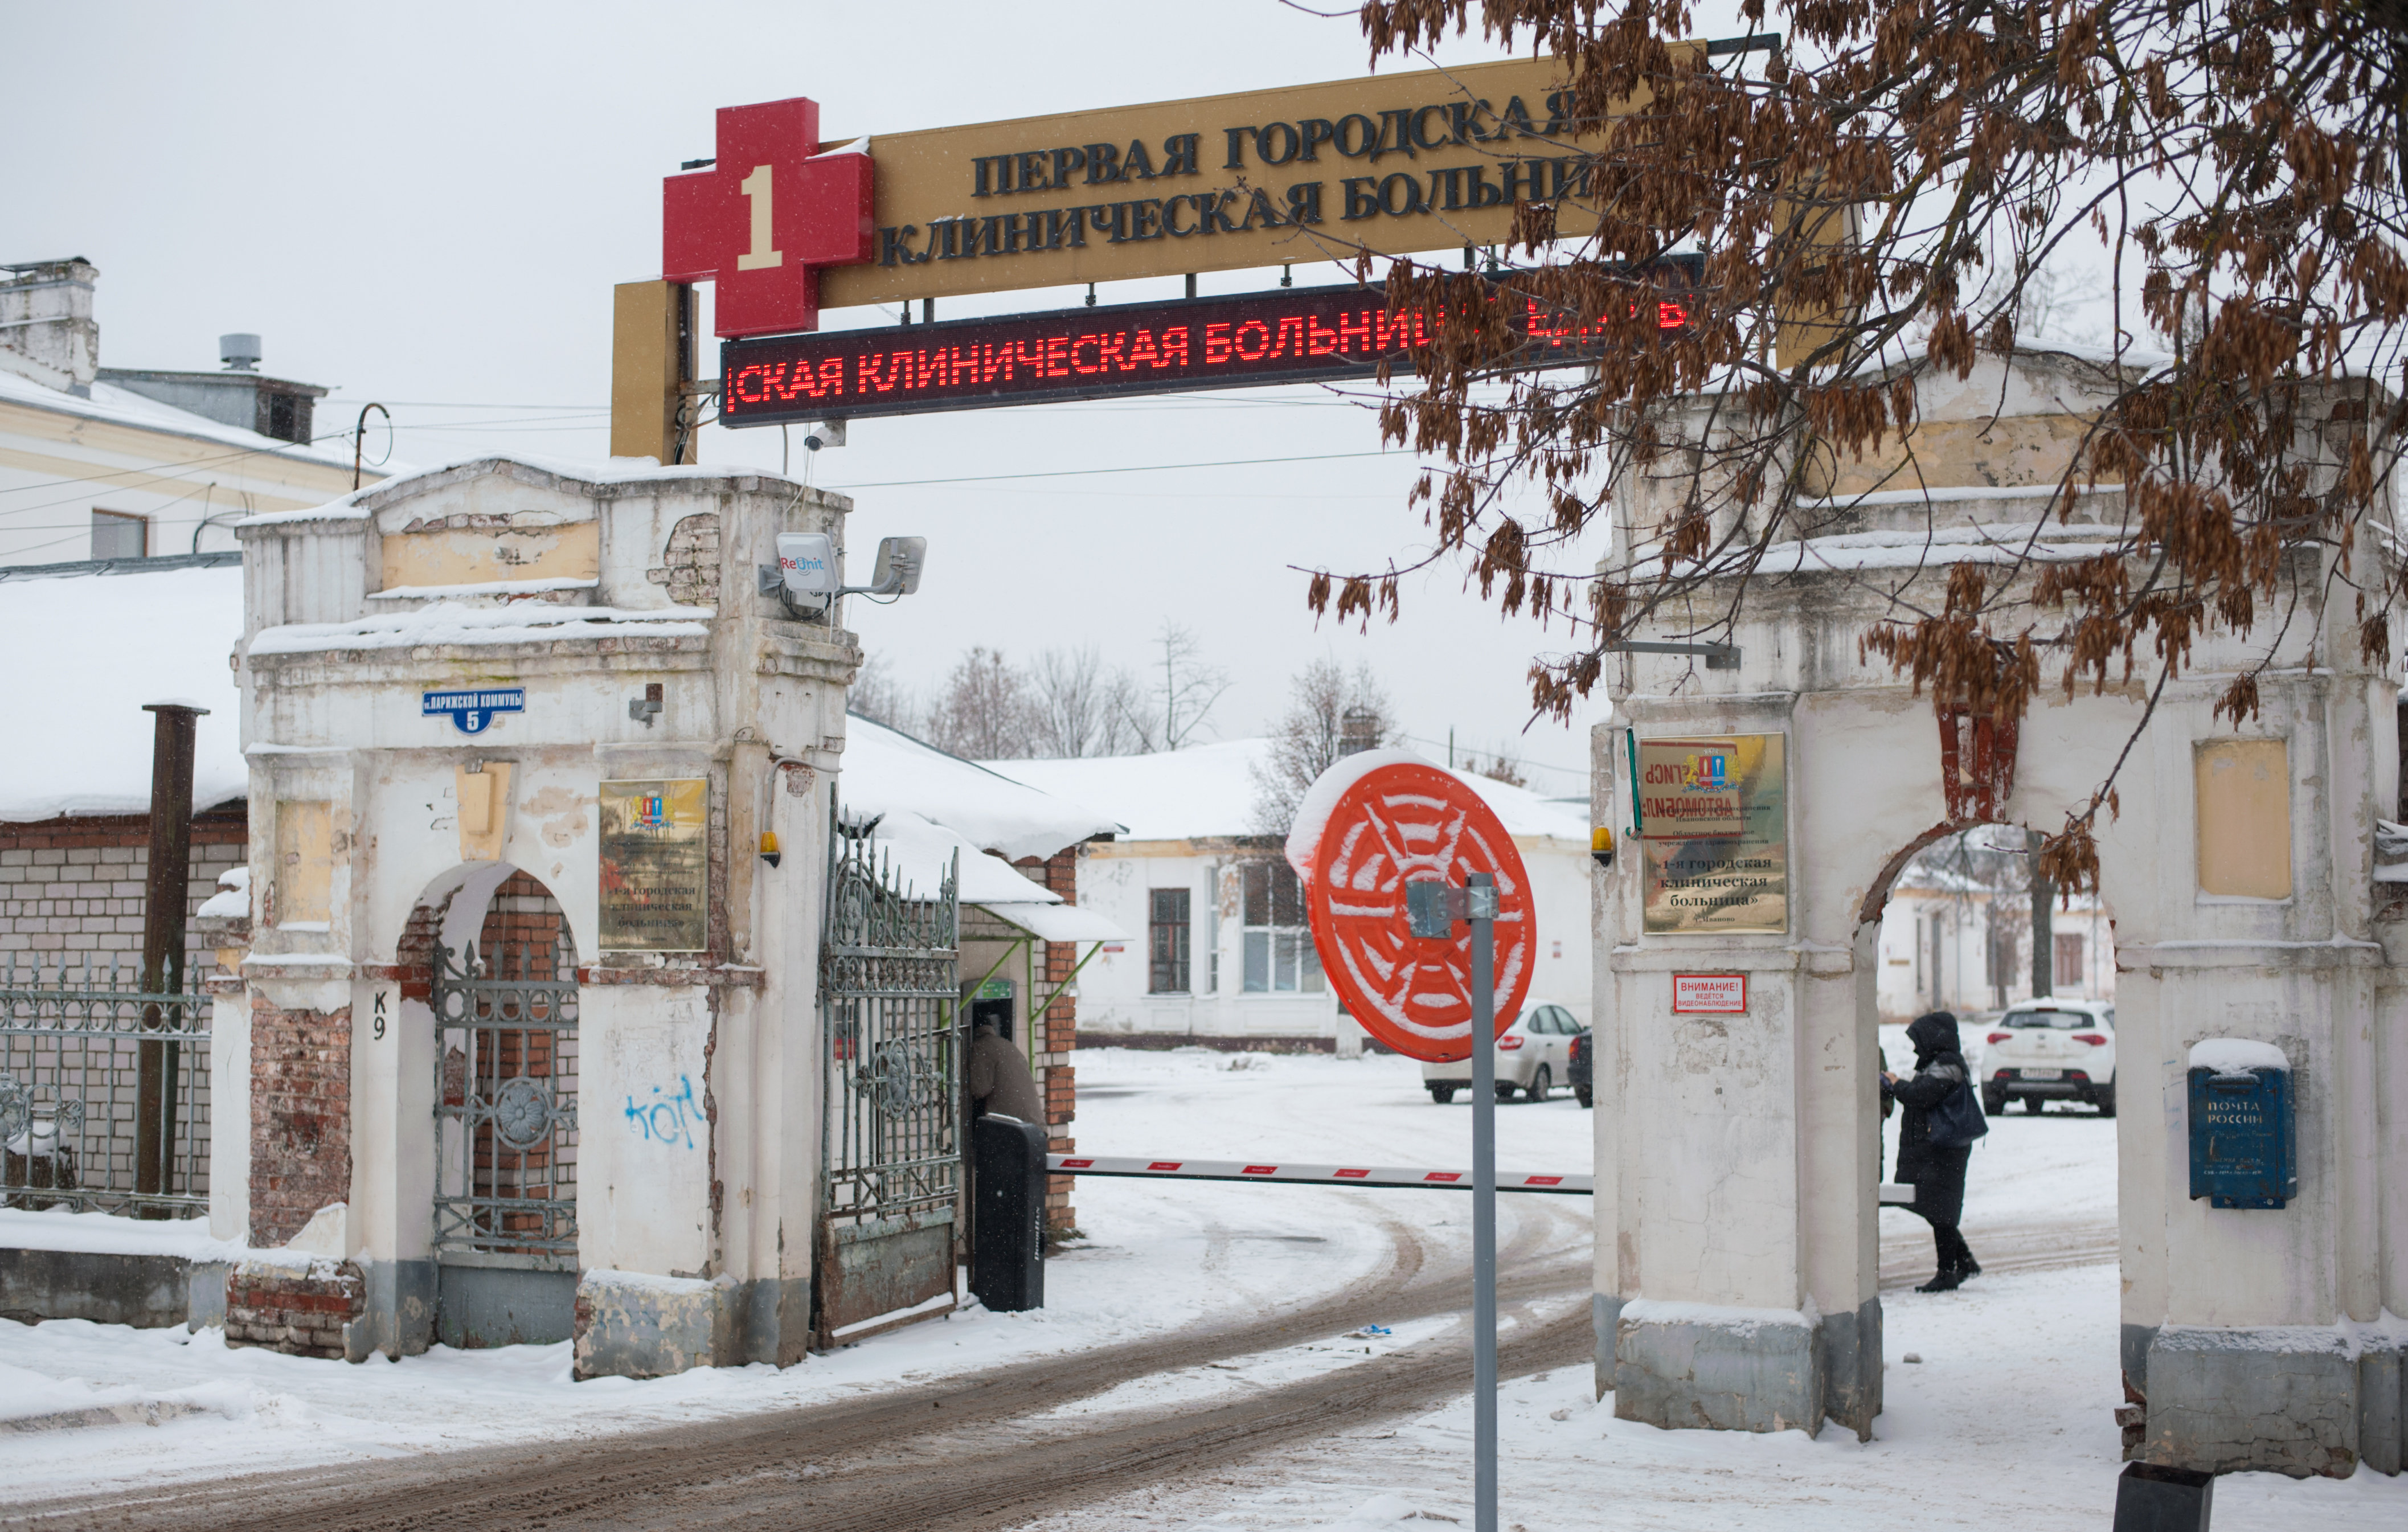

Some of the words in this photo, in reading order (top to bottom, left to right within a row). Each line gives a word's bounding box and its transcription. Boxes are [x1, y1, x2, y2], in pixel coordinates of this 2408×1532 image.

[971, 133, 1198, 198] ПЕРВАЯ
[1223, 89, 1576, 169] ГОРОДСКАЯ
[878, 181, 1323, 267] КЛИНИЧЕСКАЯ
[1340, 154, 1602, 221] БОЛЬНИ
[738, 164, 783, 271] 1
[727, 358, 843, 413] СКАЯ
[858, 326, 1188, 394] КЛИНИЧЕСКАЯ
[780, 557, 824, 570] ReUnit
[481, 693, 522, 708] КОММУНЫ
[467, 711, 479, 731] 5
[1689, 858, 1772, 871] городская
[1661, 877, 1767, 888] клиническая
[633, 886, 695, 898] городская
[1670, 894, 1759, 907] больница»
[1681, 982, 1738, 992] ВНИМАНИЕ!
[2208, 1101, 2260, 1111] ПОЧТА
[2208, 1114, 2262, 1124] РОССИИ
